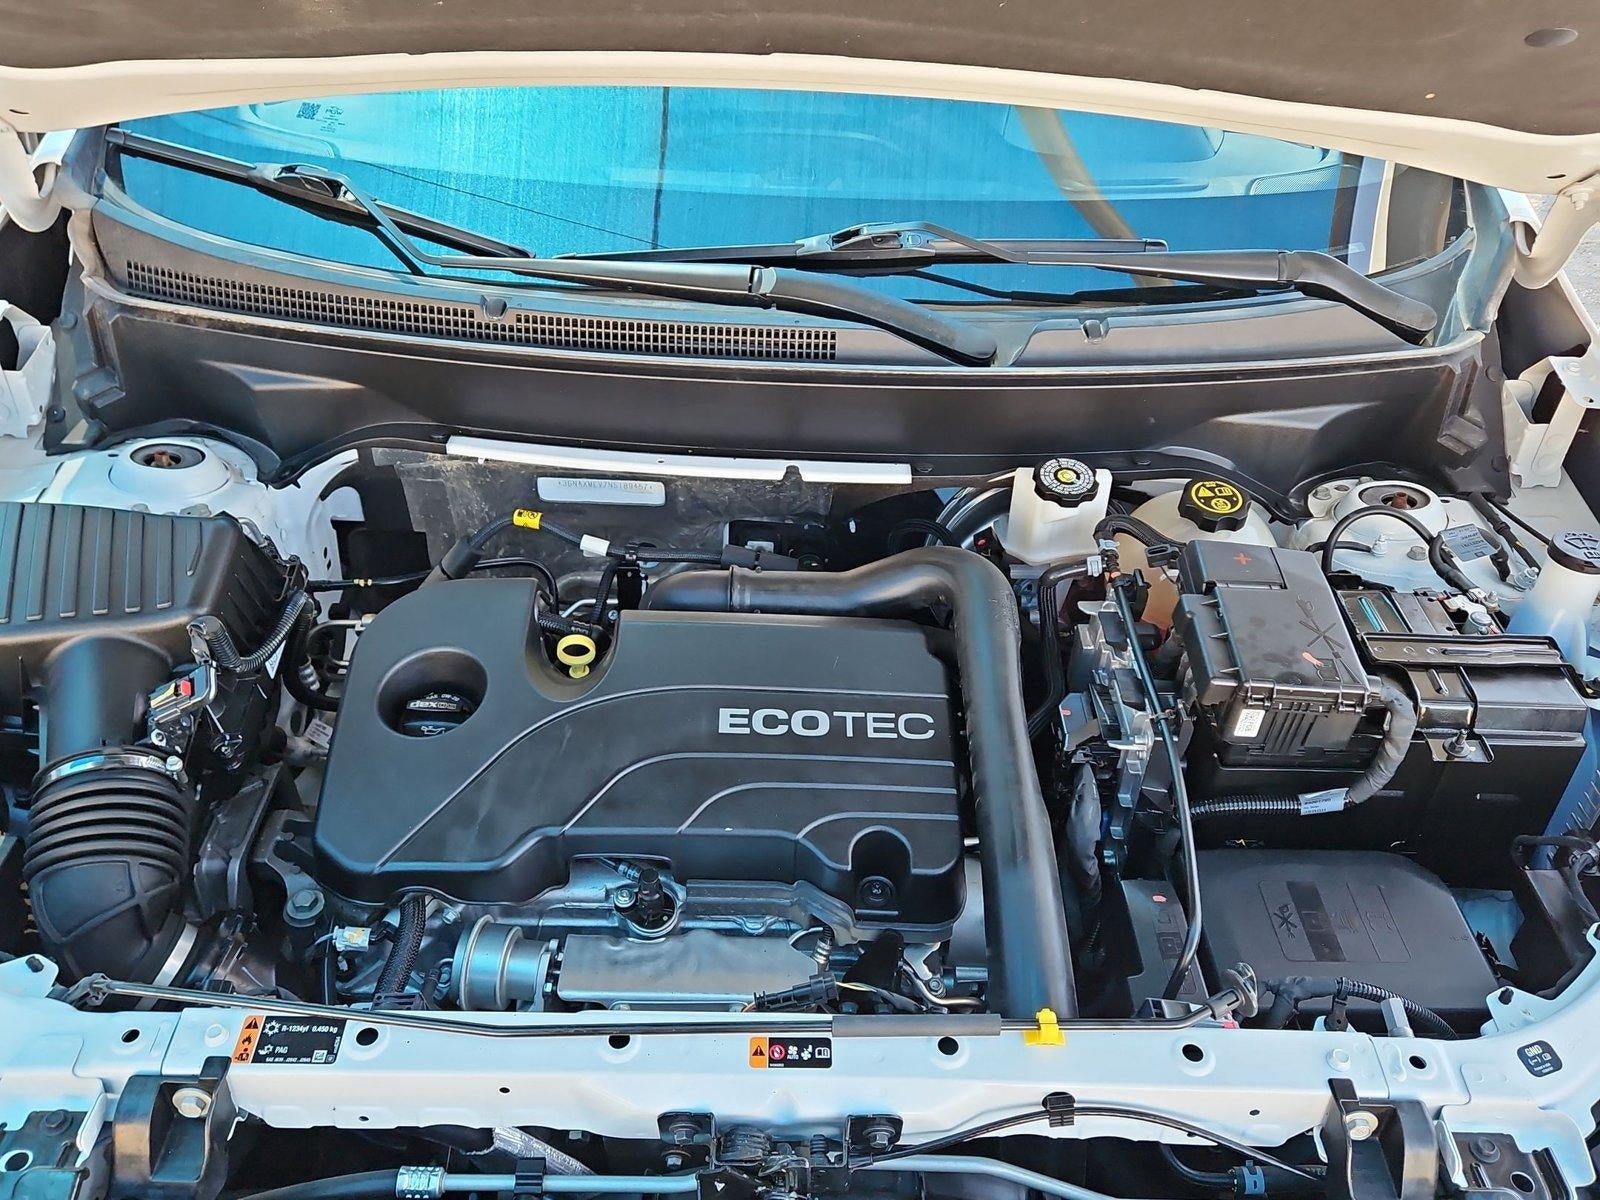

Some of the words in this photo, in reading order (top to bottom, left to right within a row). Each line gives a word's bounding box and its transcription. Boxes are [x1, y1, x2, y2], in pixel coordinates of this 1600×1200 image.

[718, 707, 936, 740] ECOTEC
[281, 1025, 309, 1033] R-1234yf
[312, 1025, 330, 1033] 0.450
[329, 1025, 338, 1033] kg
[275, 1046, 288, 1054] PAG
[1525, 1044, 1542, 1057] GND
